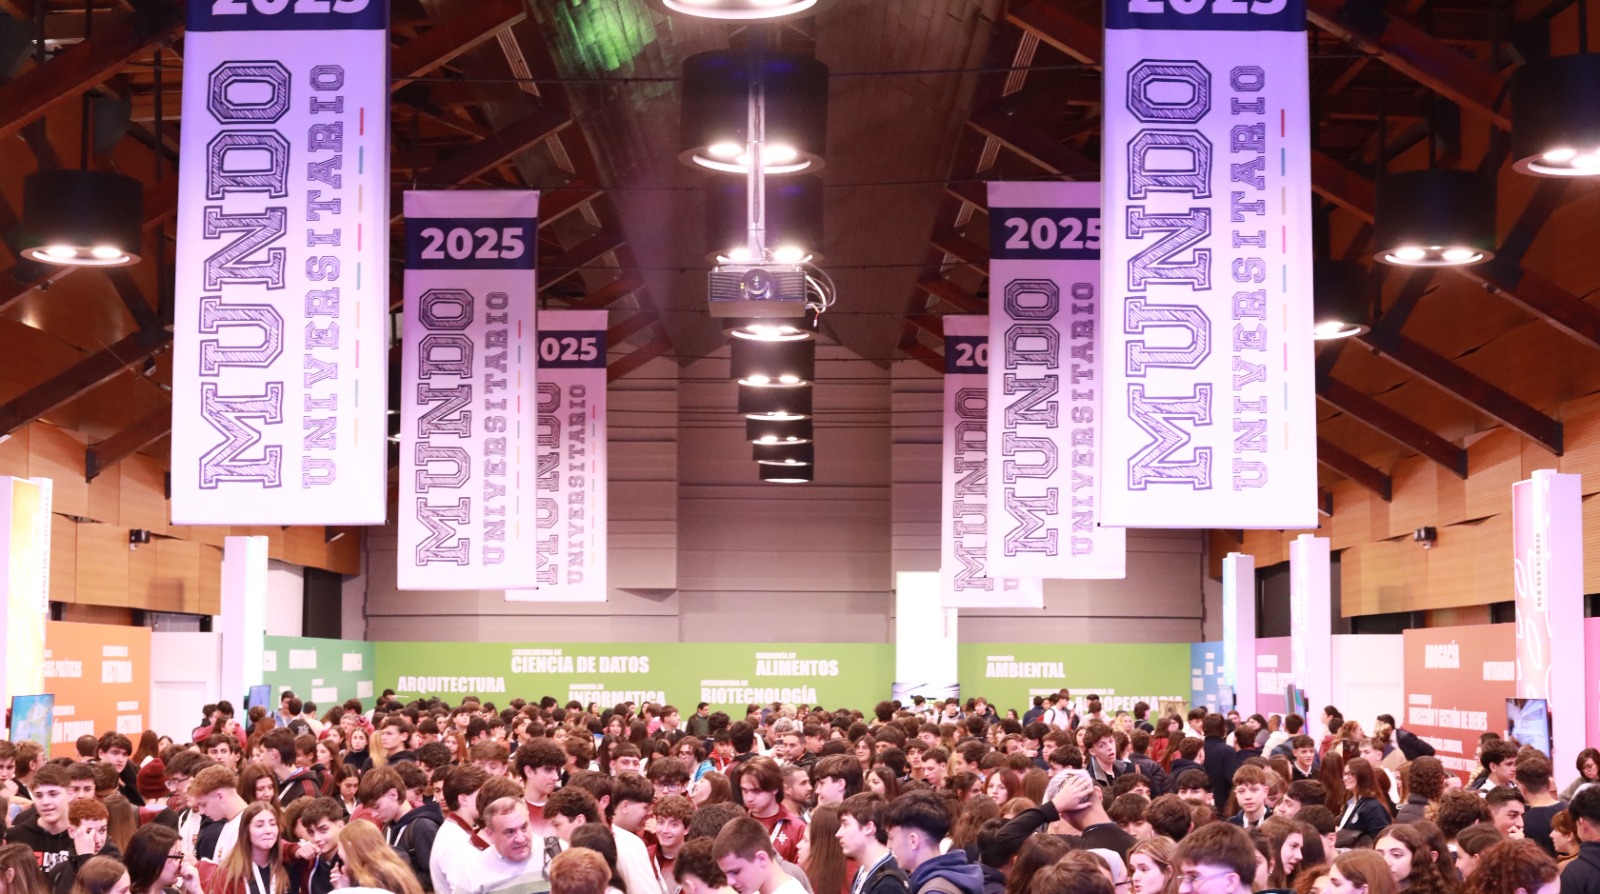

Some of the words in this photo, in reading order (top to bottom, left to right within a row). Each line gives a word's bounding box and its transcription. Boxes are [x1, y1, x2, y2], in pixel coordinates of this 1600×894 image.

[199, 59, 292, 490] MUNDO
[301, 64, 345, 489] UNIVERSITARIO
[420, 227, 525, 260] 2025
[1124, 58, 1213, 492] MUNDO
[1229, 65, 1268, 492] UNIVERSITARIO
[415, 288, 474, 567] MUNDO
[482, 291, 509, 567] UNIVERSITARIO
[538, 337, 598, 361] 025
[955, 342, 988, 367] 20
[1002, 278, 1060, 557] MUNDO
[1070, 282, 1095, 558] UNIVERSITARIO
[566, 384, 586, 585] UNIVERSITARIO
[397, 676, 506, 694] ARQUITECTURA
[511, 656, 574, 673] CIENCIA
[577, 656, 597, 673] DE
[599, 656, 650, 673] DATOS
[701, 685, 818, 704] BIOTECNOLOGÍA
[755, 659, 839, 676] ALIMENTOS
[985, 662, 1066, 678] AMBIENTAL
